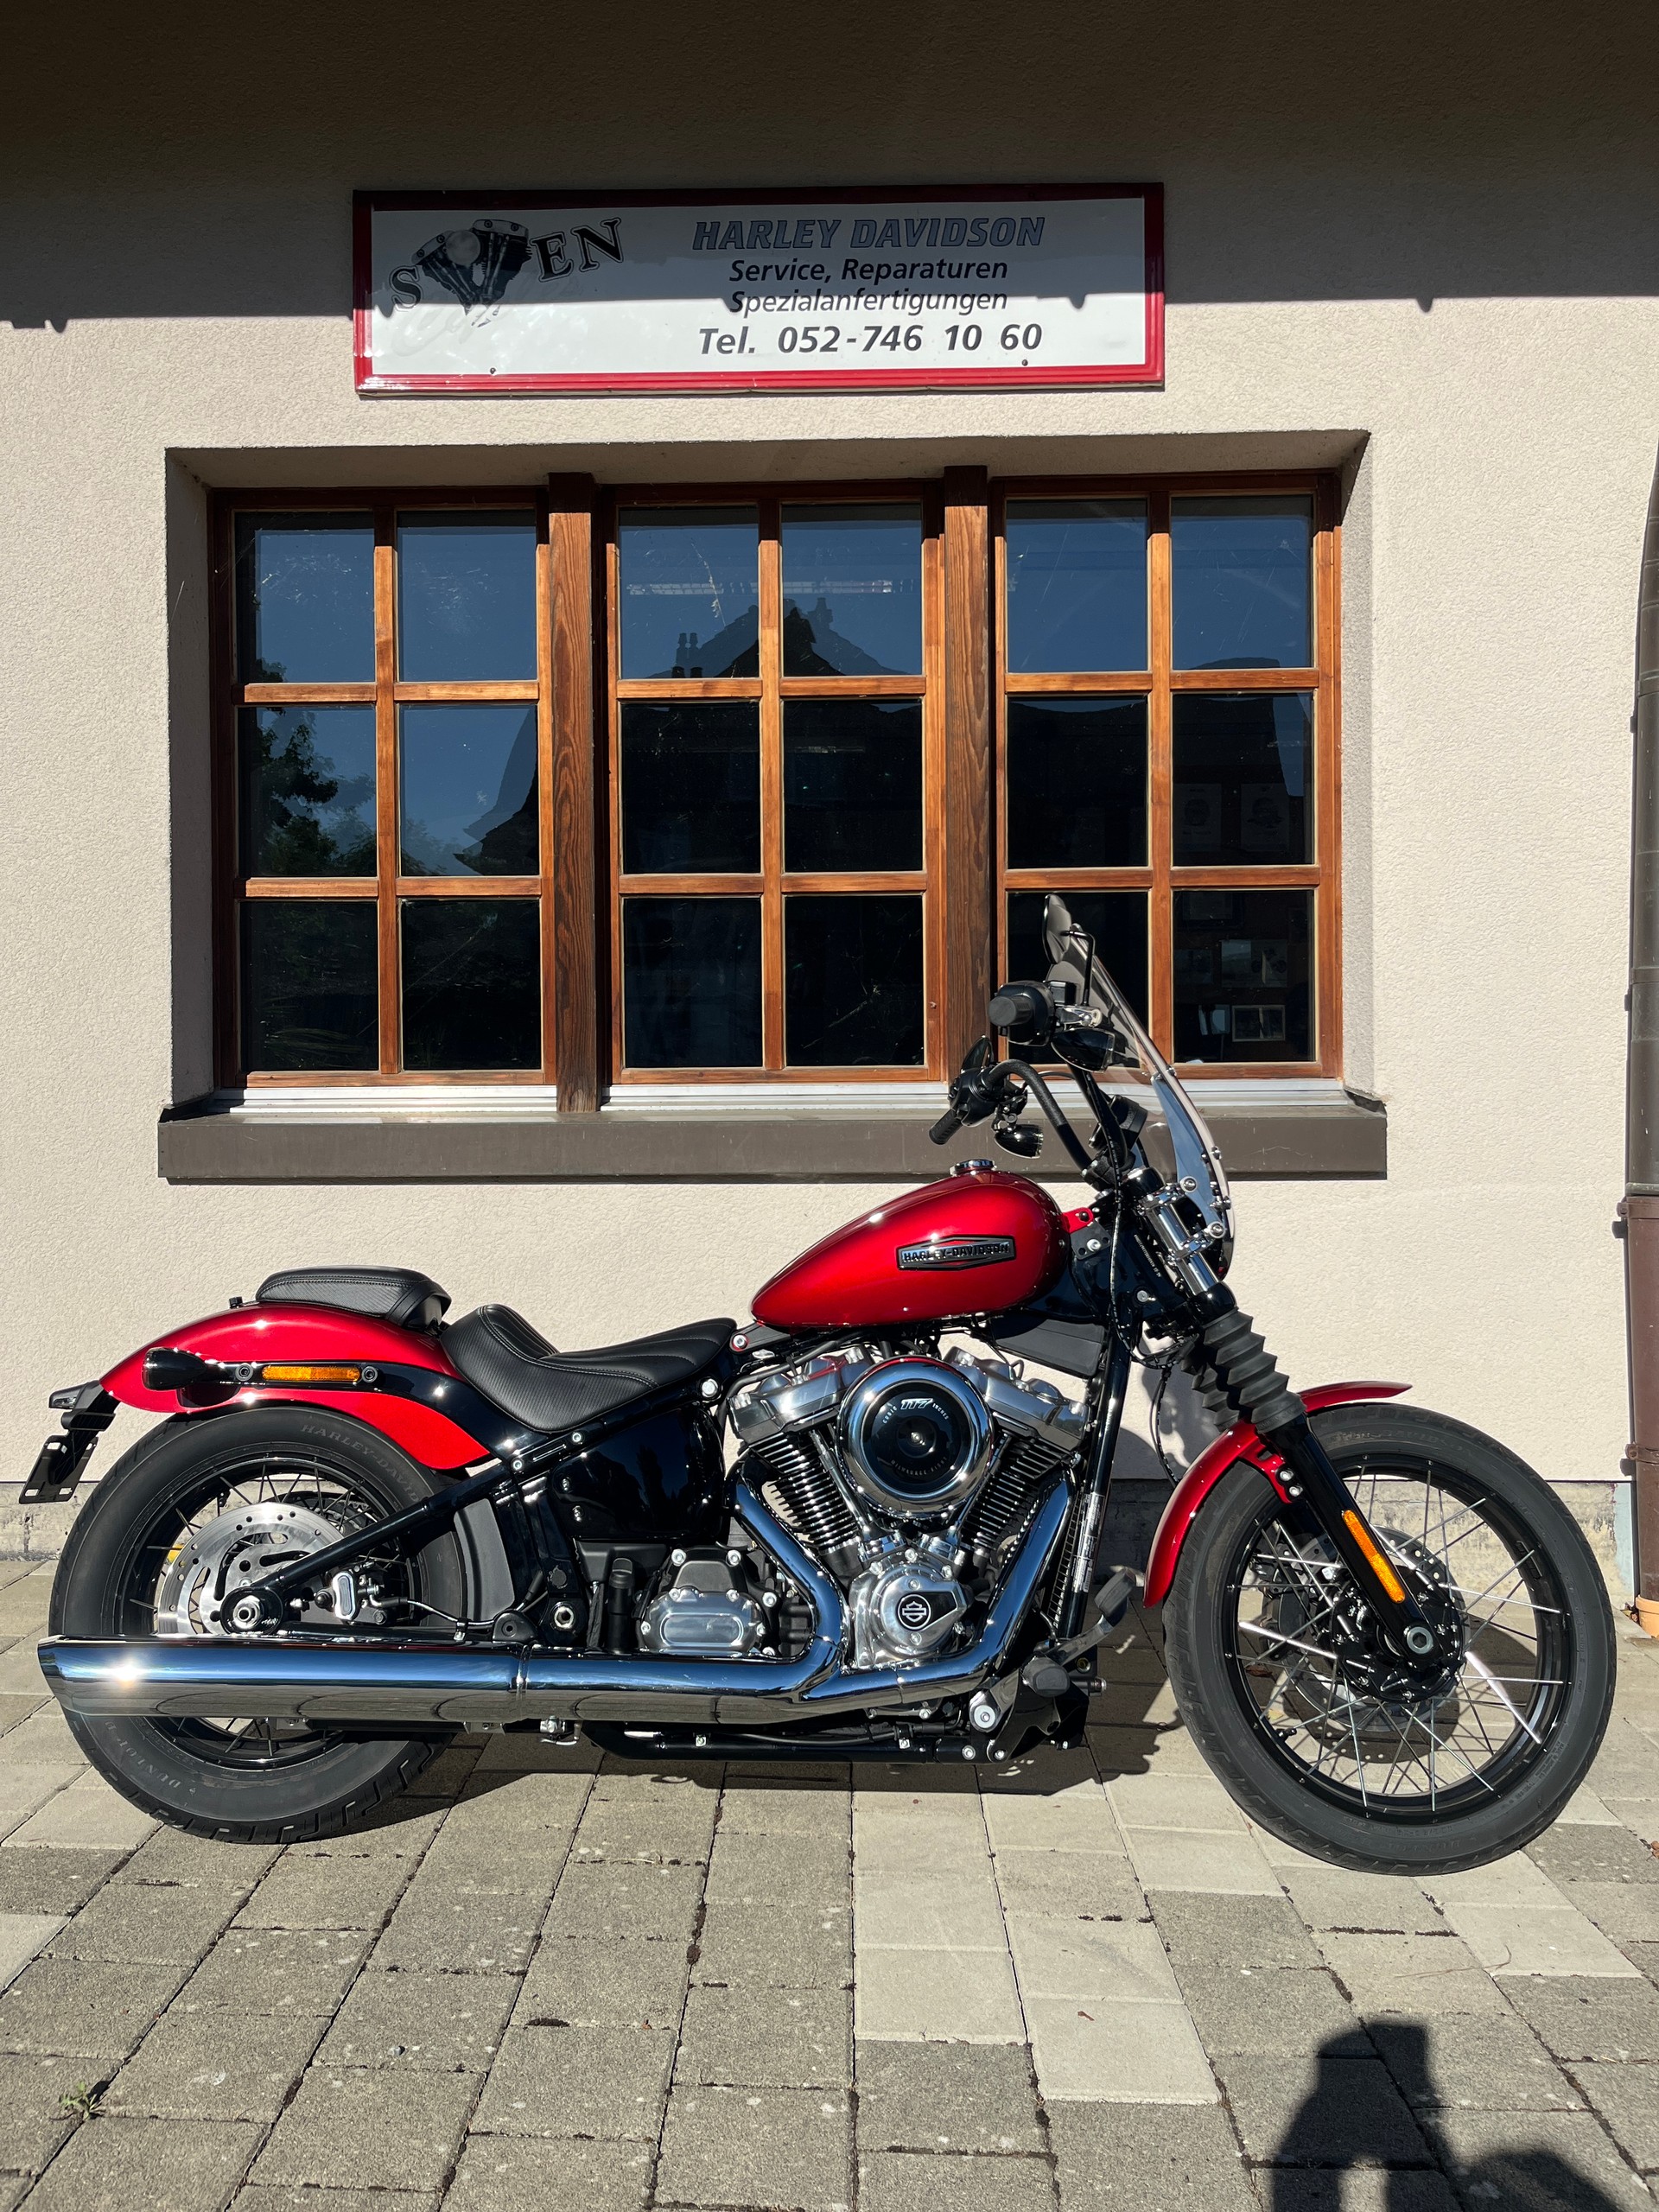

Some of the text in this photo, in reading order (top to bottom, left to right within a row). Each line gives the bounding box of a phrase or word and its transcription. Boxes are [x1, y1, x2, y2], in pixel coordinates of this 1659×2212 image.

[692, 217, 1046, 251] HARLEY DAVIDSON
[729, 257, 1008, 286] Service, Reparaturen
[731, 288, 1008, 319] Spezialanfertigungen
[699, 326, 756, 355] Tel.
[944, 324, 982, 352] 10
[1000, 323, 1043, 351] 60
[903, 1243, 1010, 1263] HARLEY-DAVIDSON
[900, 1398, 933, 1409] 117
